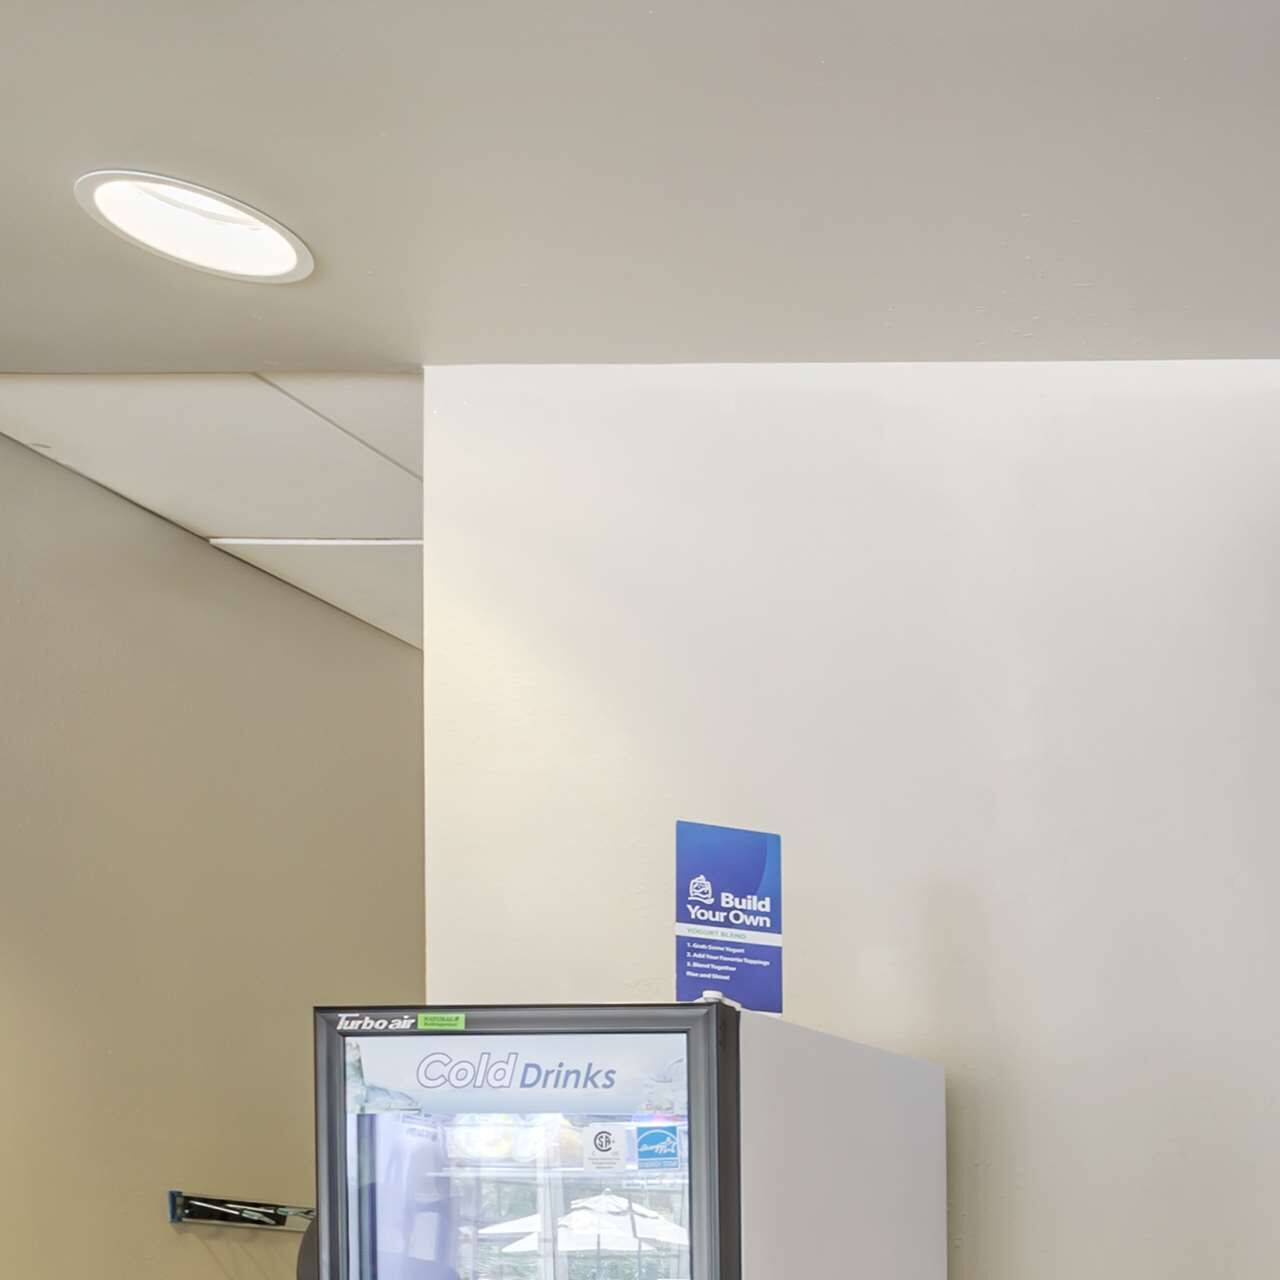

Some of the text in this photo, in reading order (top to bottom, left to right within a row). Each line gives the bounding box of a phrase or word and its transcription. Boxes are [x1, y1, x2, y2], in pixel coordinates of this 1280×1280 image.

[721, 892, 771, 912] Build
[686, 904, 771, 928] Your Own
[336, 1013, 416, 1030] Turbo air
[416, 1051, 617, 1090] Cold Drinks
